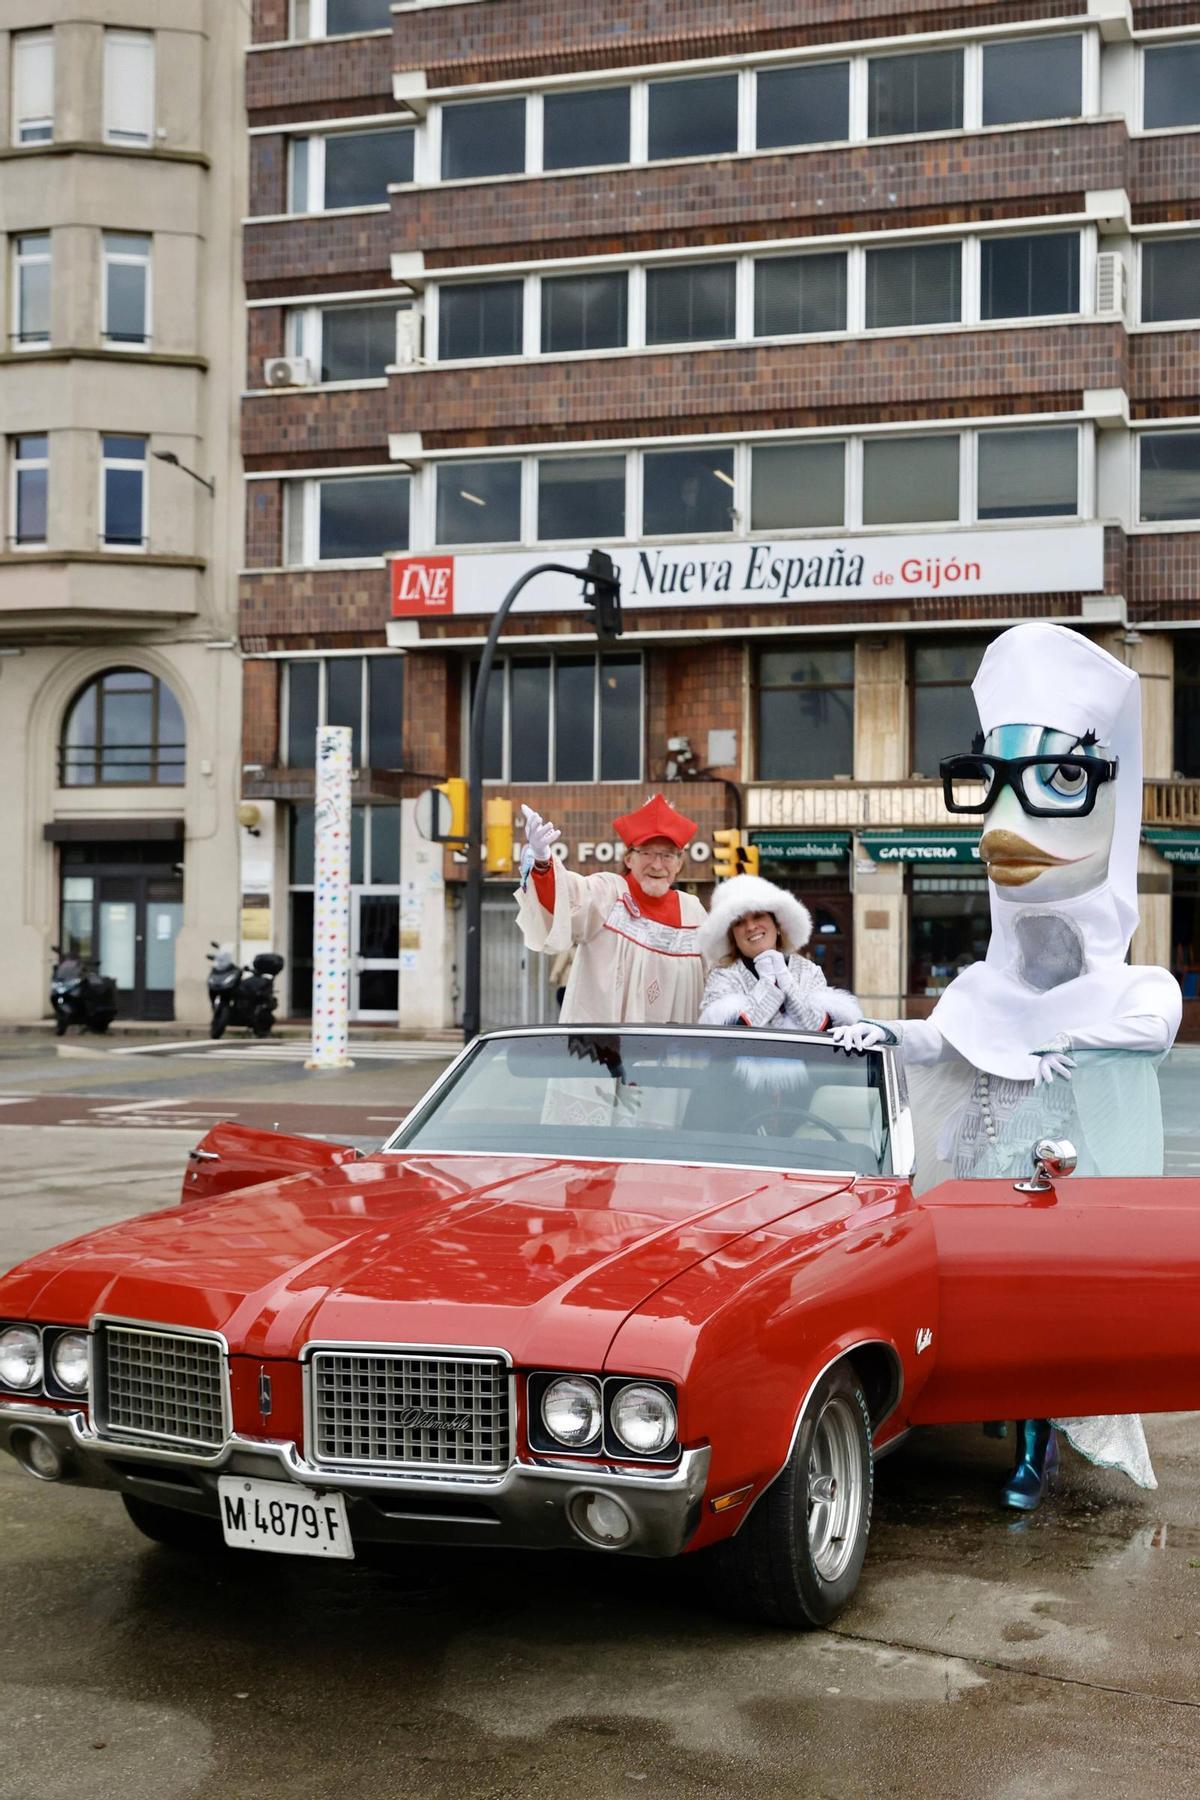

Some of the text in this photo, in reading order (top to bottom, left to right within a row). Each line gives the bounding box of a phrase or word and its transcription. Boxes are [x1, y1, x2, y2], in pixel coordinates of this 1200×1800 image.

[630, 550, 734, 595] Nueva
[741, 544, 865, 598] España
[872, 570, 895, 586] de
[900, 556, 982, 589] Gijón
[397, 566, 452, 601] LNE
[758, 843, 784, 857] latos
[879, 846, 957, 859] CAFETERIA
[1163, 847, 1200, 861] meriend
[400, 1407, 472, 1430] Oldsmobile
